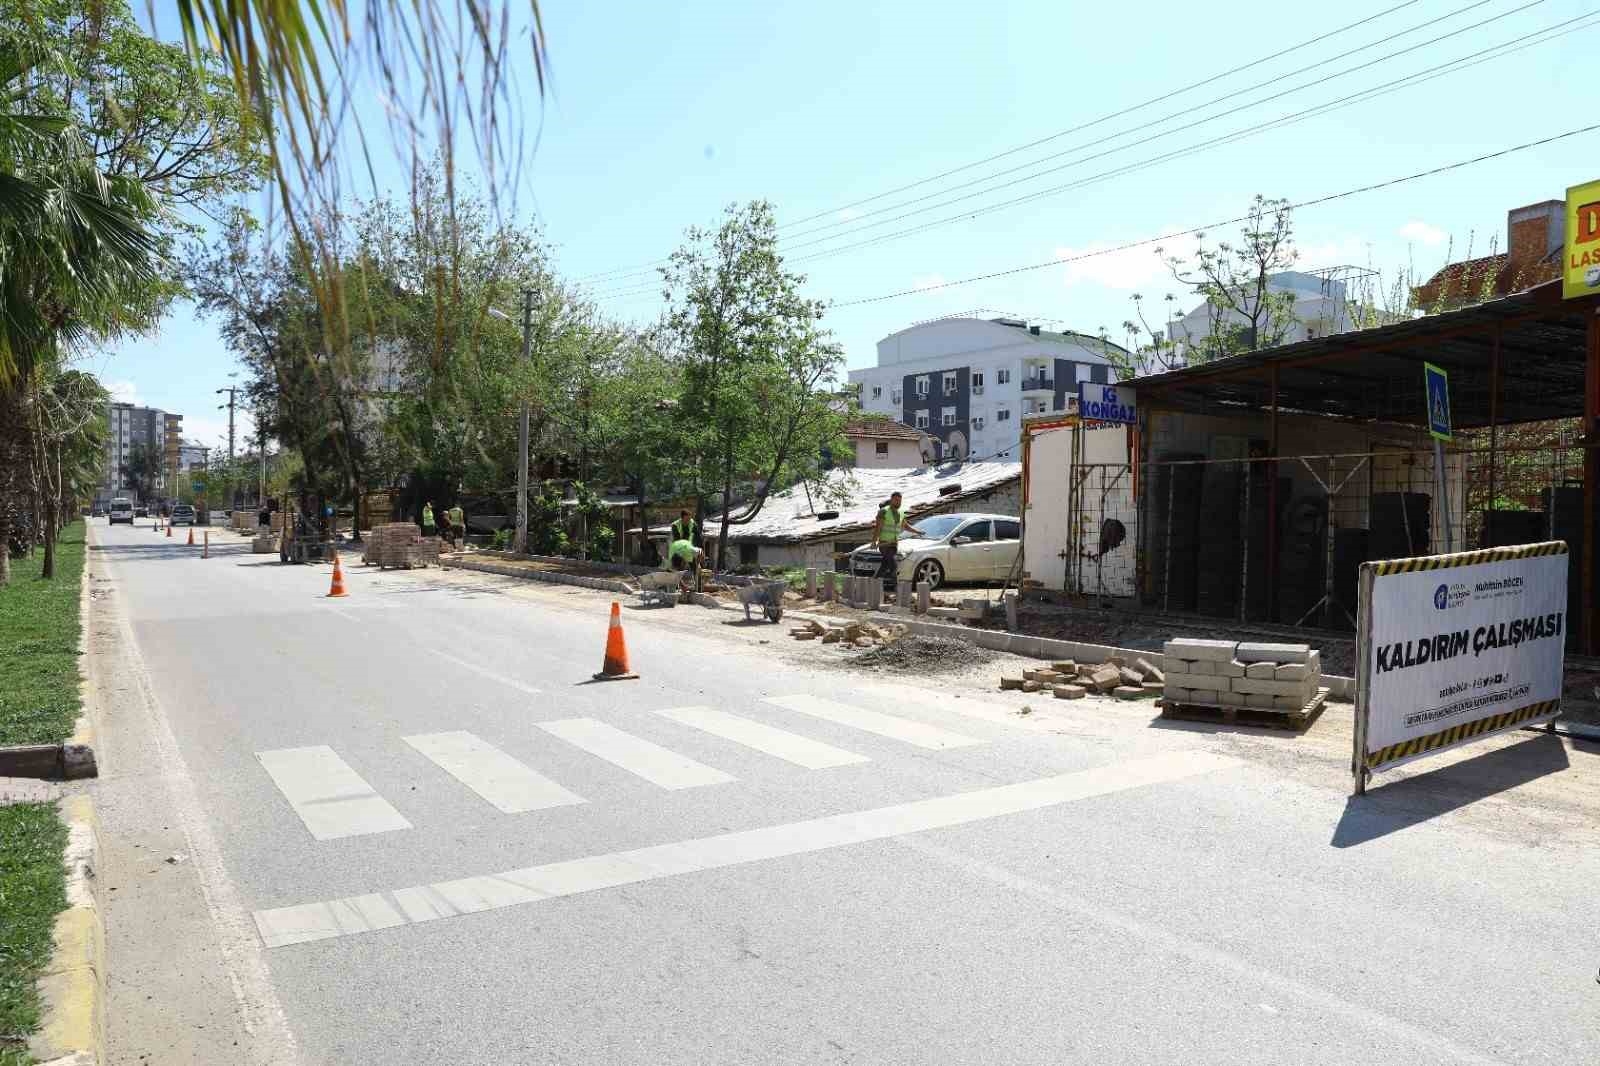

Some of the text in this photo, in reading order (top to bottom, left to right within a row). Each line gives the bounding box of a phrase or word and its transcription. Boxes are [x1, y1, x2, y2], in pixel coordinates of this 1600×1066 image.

[1081, 401, 1135, 420] KONGAZ
[1376, 613, 1563, 674] KALDIRIM ÇALIŞMASI
